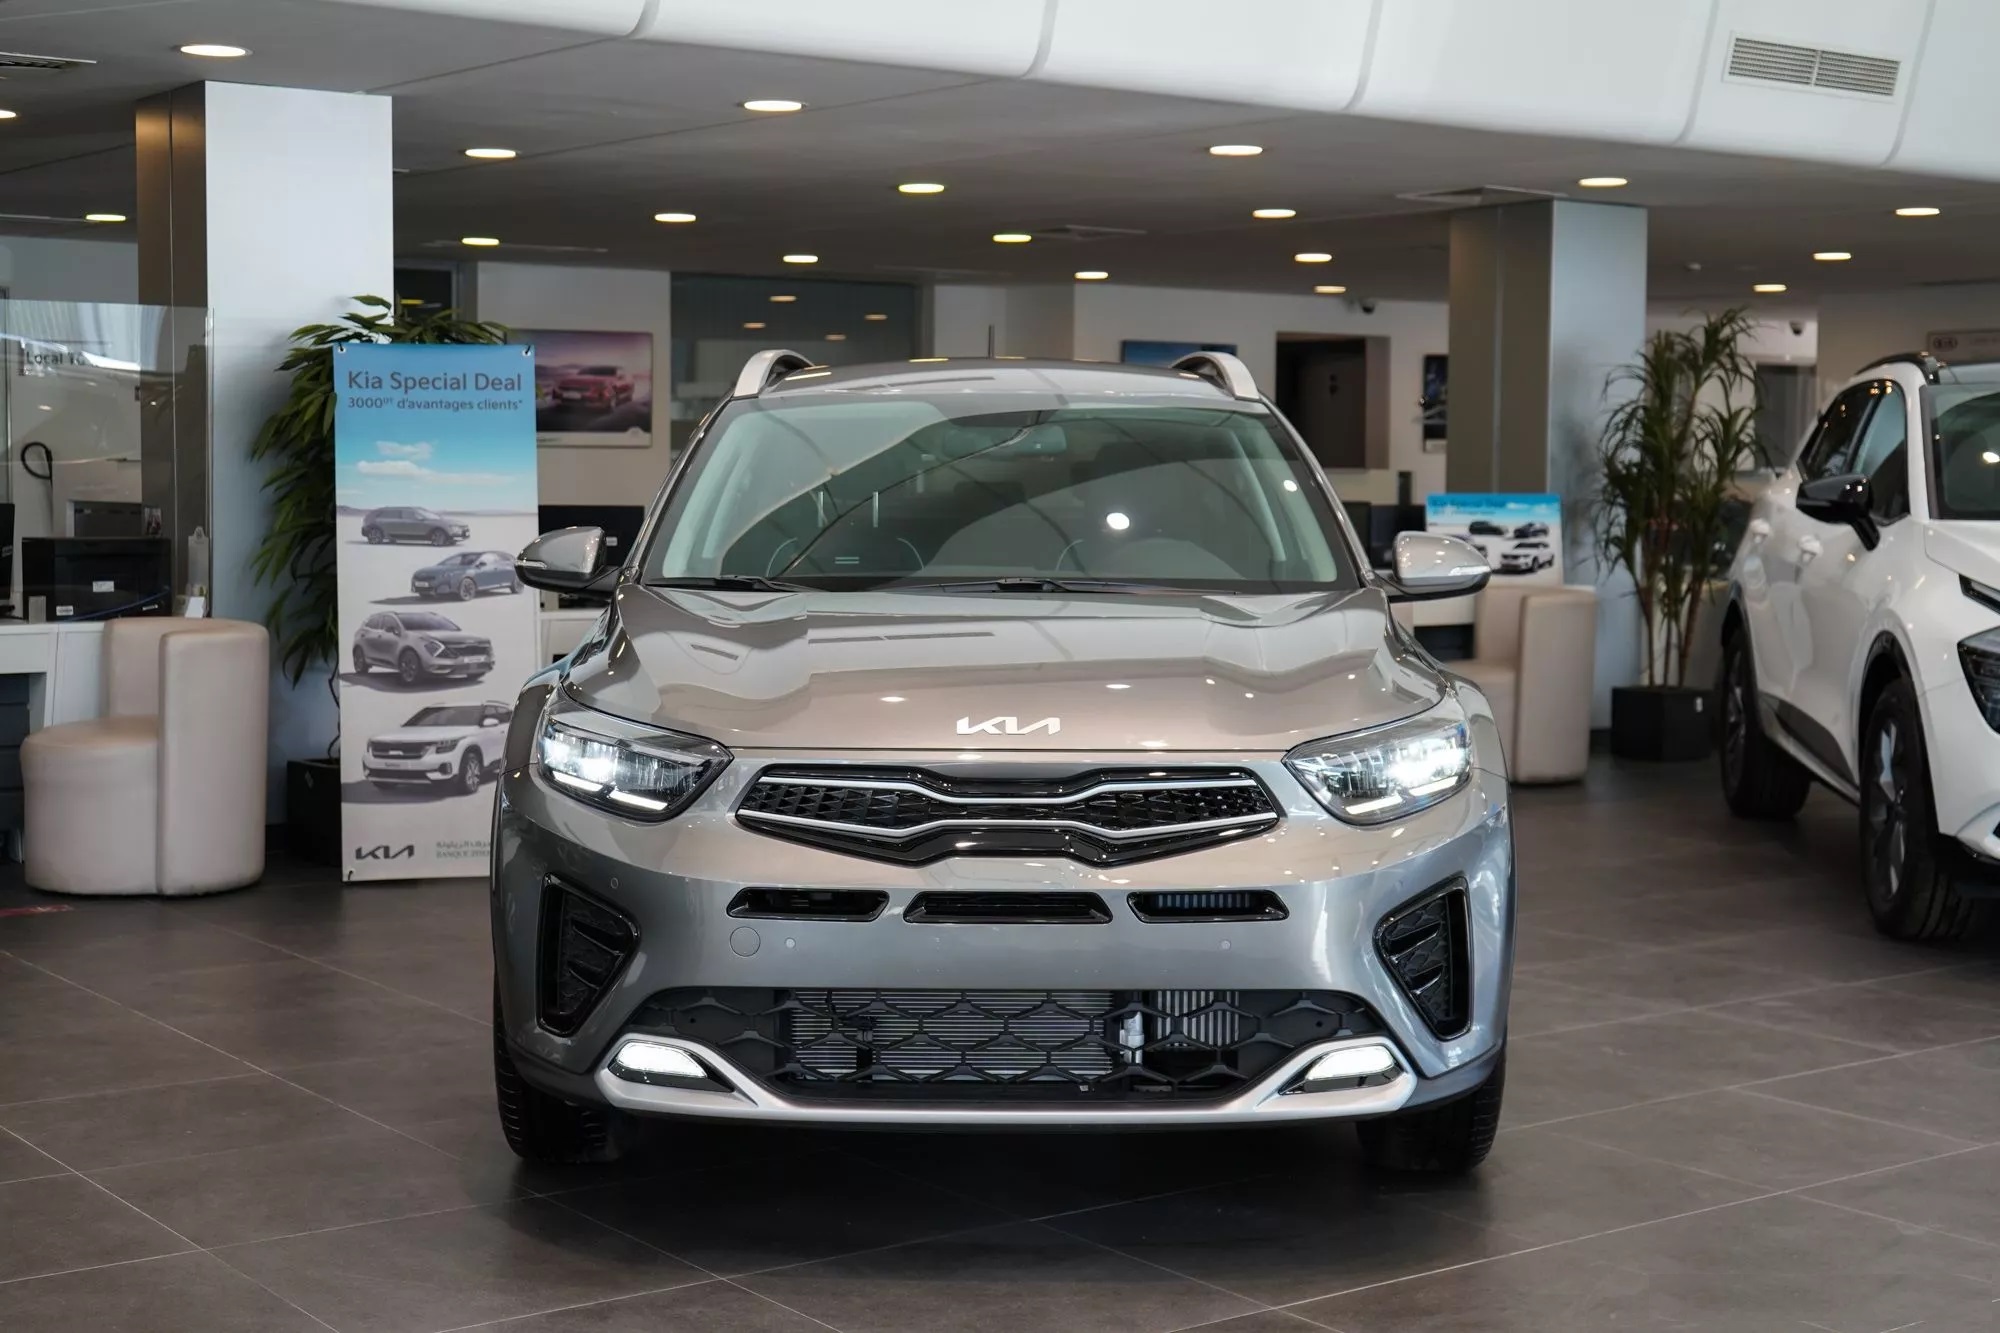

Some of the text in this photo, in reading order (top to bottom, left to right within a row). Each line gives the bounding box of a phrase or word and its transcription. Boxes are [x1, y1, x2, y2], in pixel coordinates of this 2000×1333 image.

[348, 371, 522, 394] Kia Special Deal
[396, 397, 474, 412] d'avantages
[956, 716, 1061, 735] KIA
[355, 845, 415, 860] KIA
